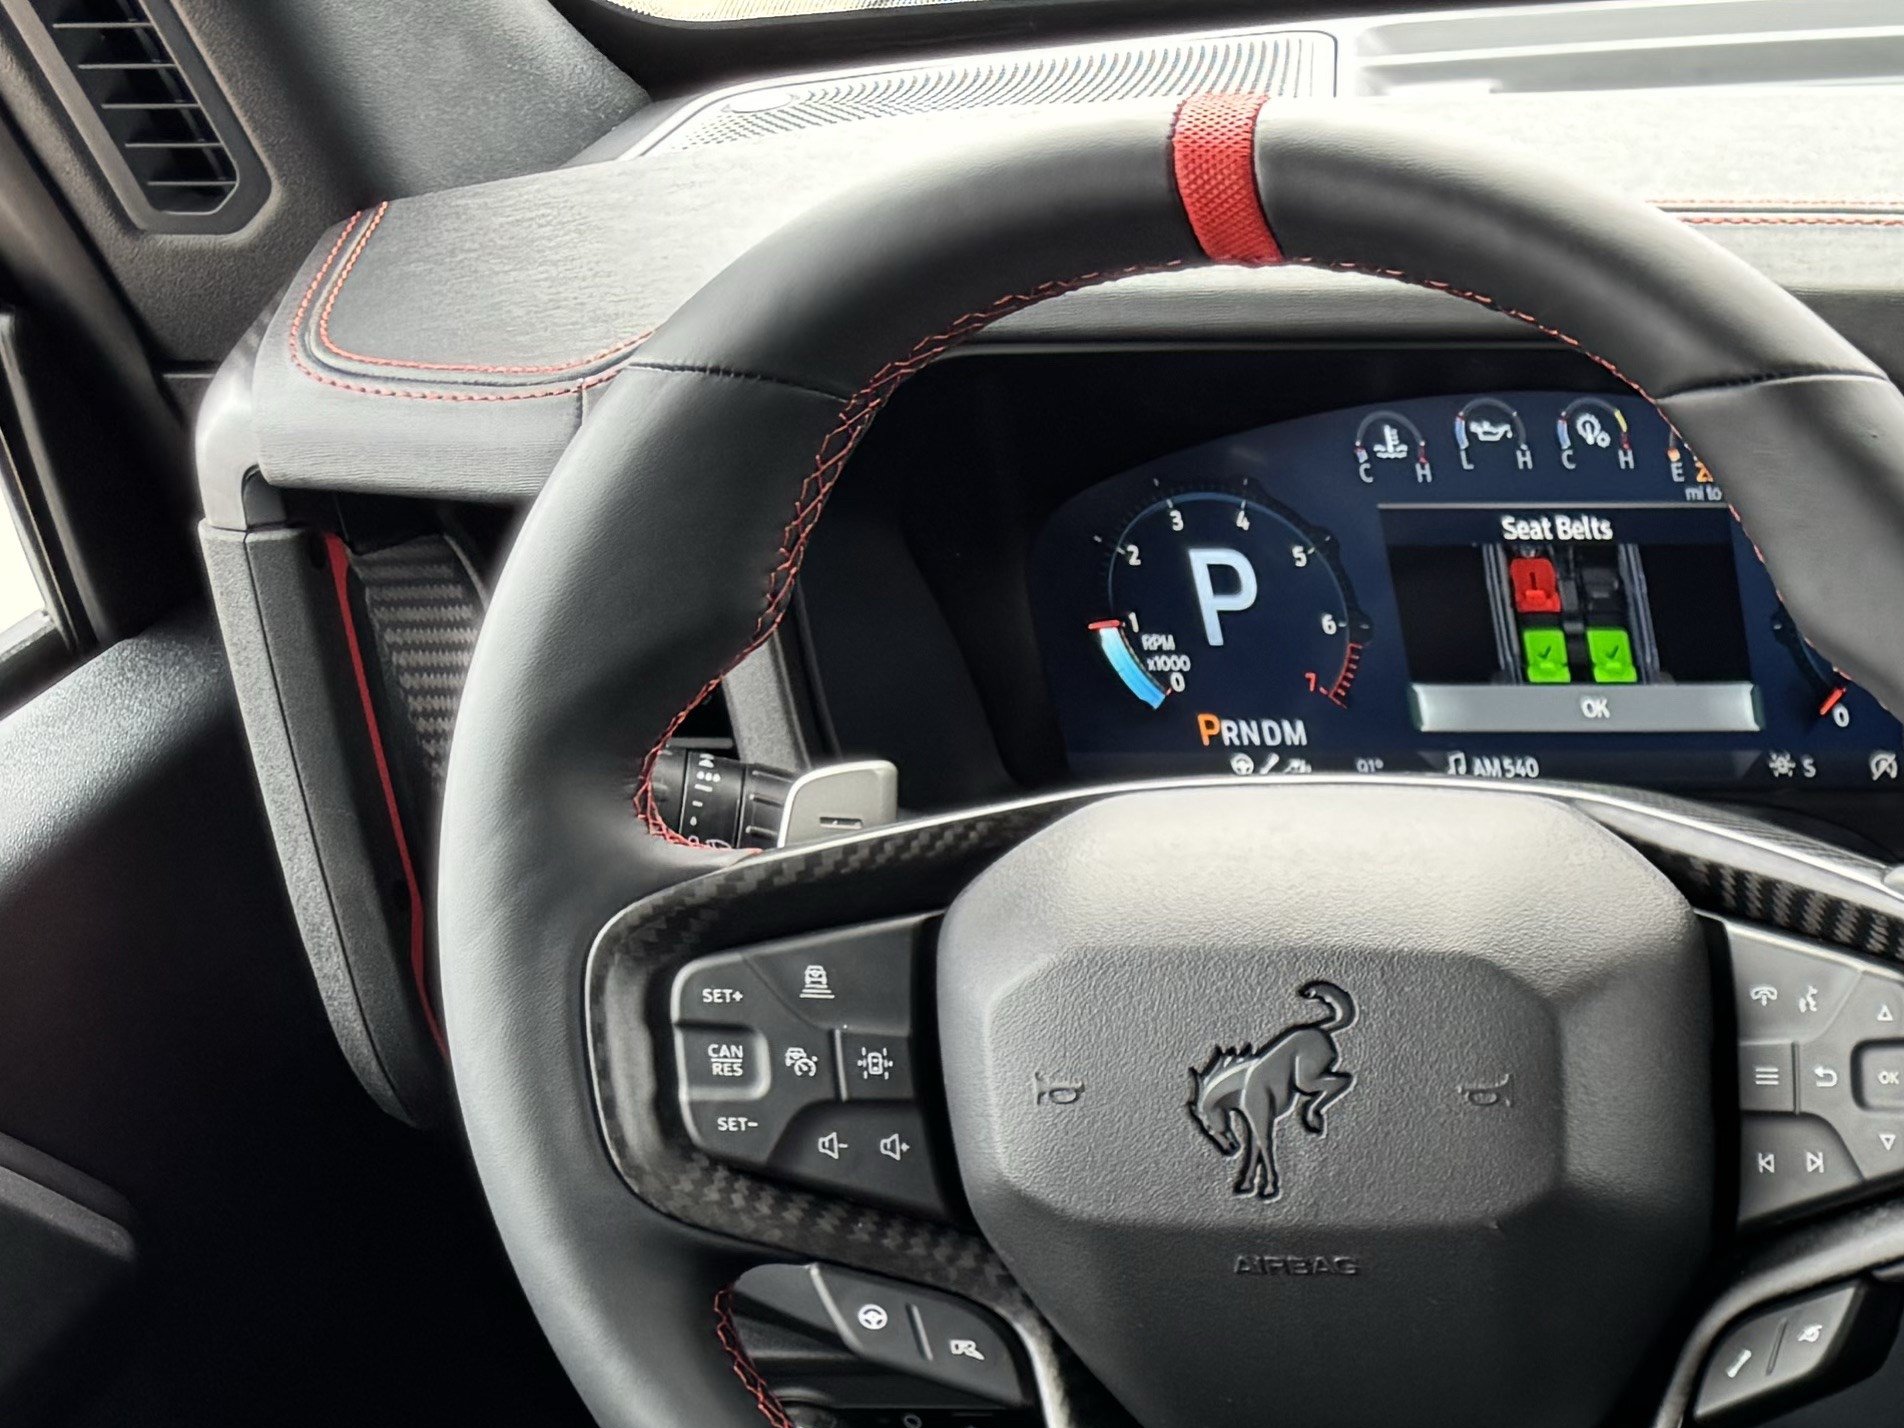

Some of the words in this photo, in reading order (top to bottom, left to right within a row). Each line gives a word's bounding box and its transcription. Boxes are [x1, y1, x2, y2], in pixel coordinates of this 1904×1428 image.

[1460, 449, 1474, 470] L
[1516, 449, 1533, 470] H
[1561, 449, 1577, 470] C
[1618, 449, 1634, 470] H
[1359, 462, 1374, 484] C
[1415, 462, 1432, 484] H
[1671, 462, 1685, 482] E
[1169, 510, 1184, 531] 3
[1236, 512, 1250, 531] 4
[1501, 515, 1550, 541] Seat
[1556, 514, 1613, 541] Belts
[1126, 544, 1141, 566] 2
[1292, 545, 1307, 567] 5
[1188, 547, 1257, 646] P
[1128, 611, 1140, 633] 1
[1320, 613, 1337, 635] 6
[1141, 633, 1176, 651] RPM
[1147, 654, 1191, 671] x1000
[1170, 672, 1186, 693] 0
[1305, 672, 1317, 692] 7
[1580, 699, 1611, 719] OK
[1832, 703, 1850, 728] 0
[1473, 755, 1501, 778] AM
[1503, 755, 1540, 778] 540
[1802, 758, 1817, 778] S
[702, 988, 743, 1003] SET+
[708, 1043, 743, 1058] CAN
[712, 1062, 743, 1076] RES
[1877, 1070, 1900, 1084] OK
[1233, 1254, 1360, 1277] AIRBAG
